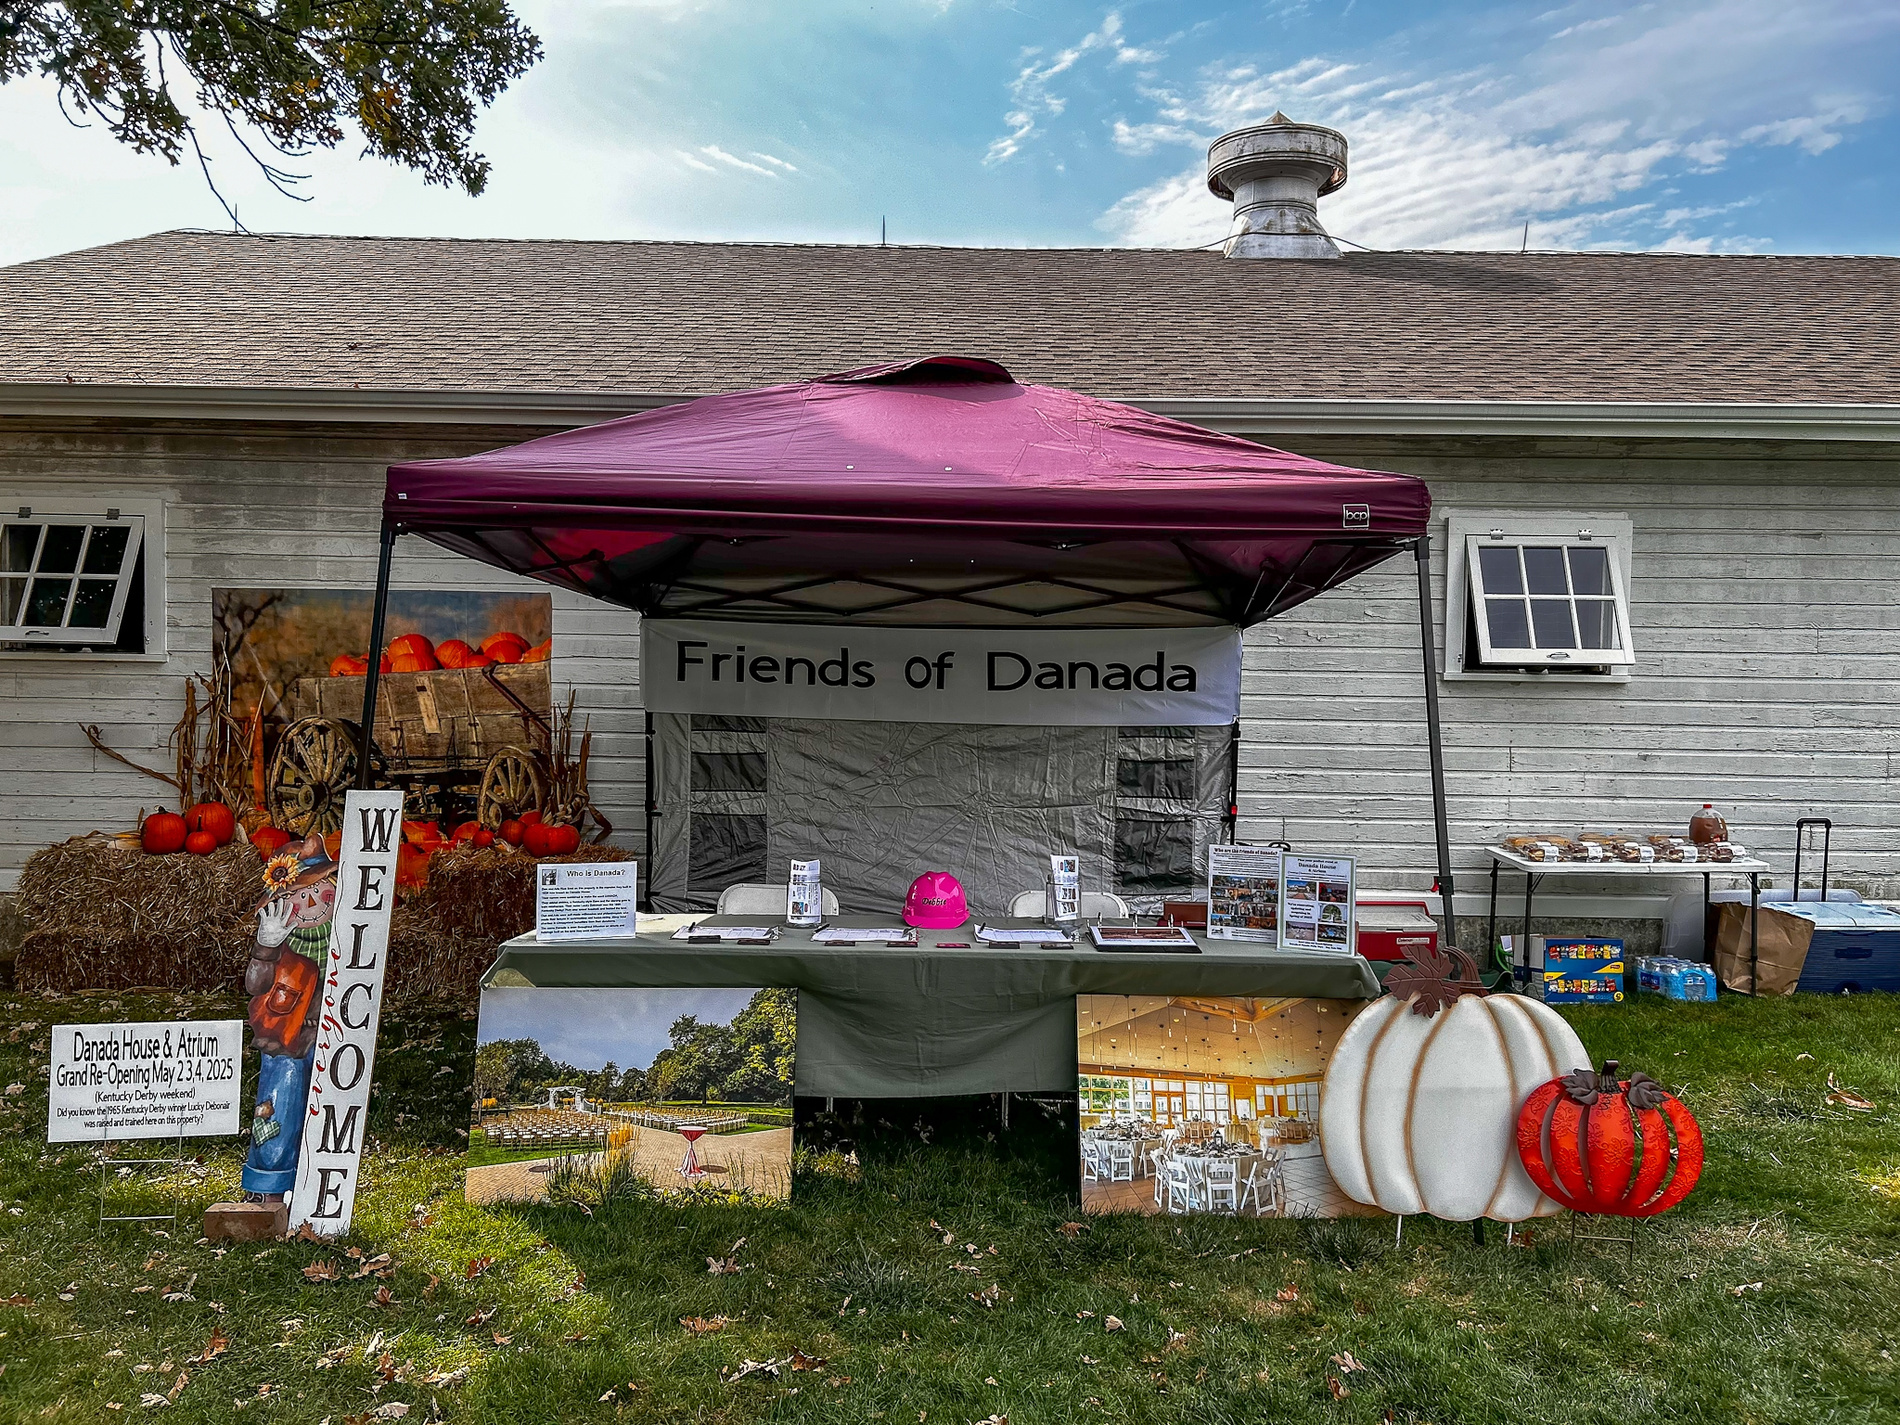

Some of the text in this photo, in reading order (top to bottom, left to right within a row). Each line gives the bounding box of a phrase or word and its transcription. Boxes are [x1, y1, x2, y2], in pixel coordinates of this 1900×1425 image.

[1345, 509, 1368, 521] bcp
[675, 639, 1198, 693] Friends of Danada
[593, 868, 626, 876] Danada?
[921, 897, 947, 906] Debbie
[309, 806, 400, 1219] WELCOME
[309, 948, 345, 1117] everyone
[73, 1027, 218, 1062] Danada House & Atrium
[56, 1063, 88, 1087] Grand
[89, 1061, 150, 1090] Re-Opening
[152, 1060, 176, 1089] May
[206, 1058, 233, 1081] 2025
[94, 1086, 196, 1103] (Kentucky Derby weekend)
[56, 1101, 231, 1119] Did you know the 1965 Kentucky Derby winner Lucky Debonair
[83, 1113, 204, 1128] was raised and trained here on this property?
